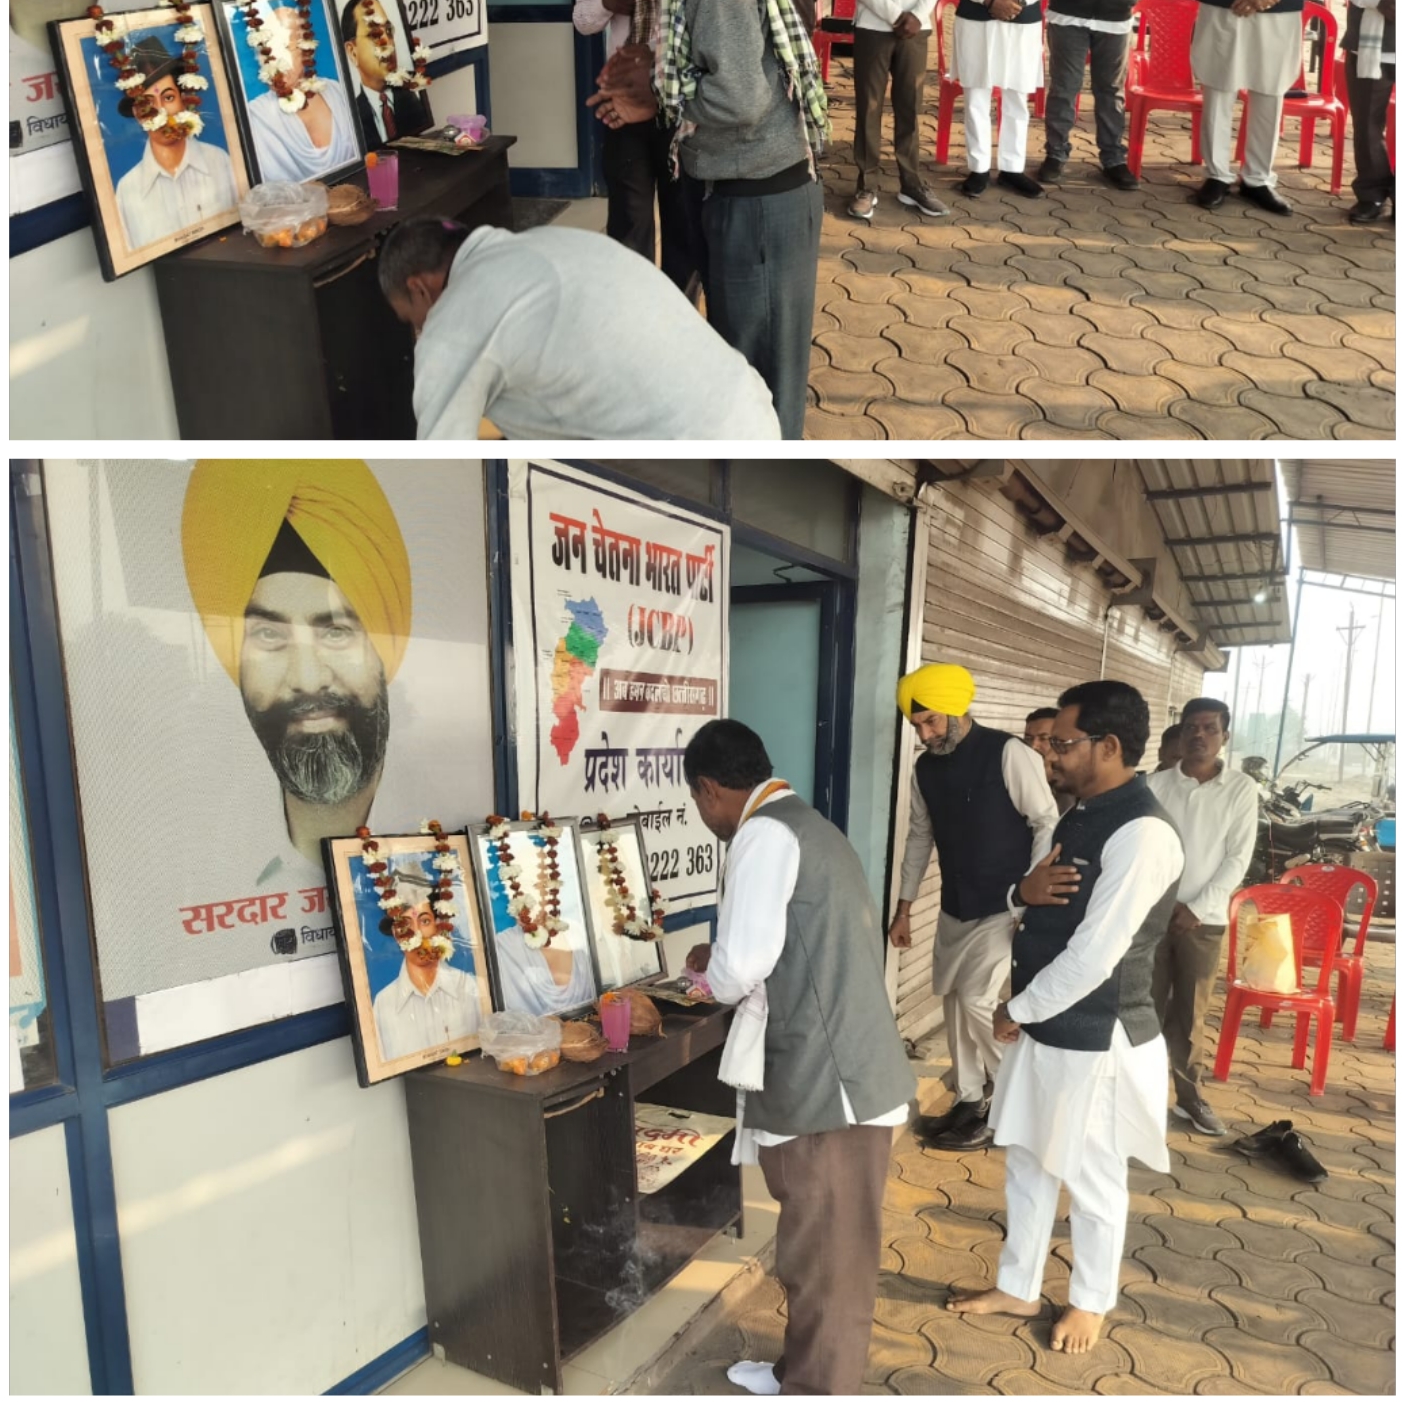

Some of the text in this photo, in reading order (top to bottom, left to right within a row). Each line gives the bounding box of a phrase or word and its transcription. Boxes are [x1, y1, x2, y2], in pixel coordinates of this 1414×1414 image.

[549, 508, 715, 603] जन चेतना भारत पार्टी
[627, 604, 694, 655] (JCBP)
[613, 680, 628, 701] अब
[585, 731, 628, 793] प्रदेश
[676, 803, 688, 826] नं.
[646, 843, 713, 882] 222 363
[179, 892, 288, 935] सरदार
